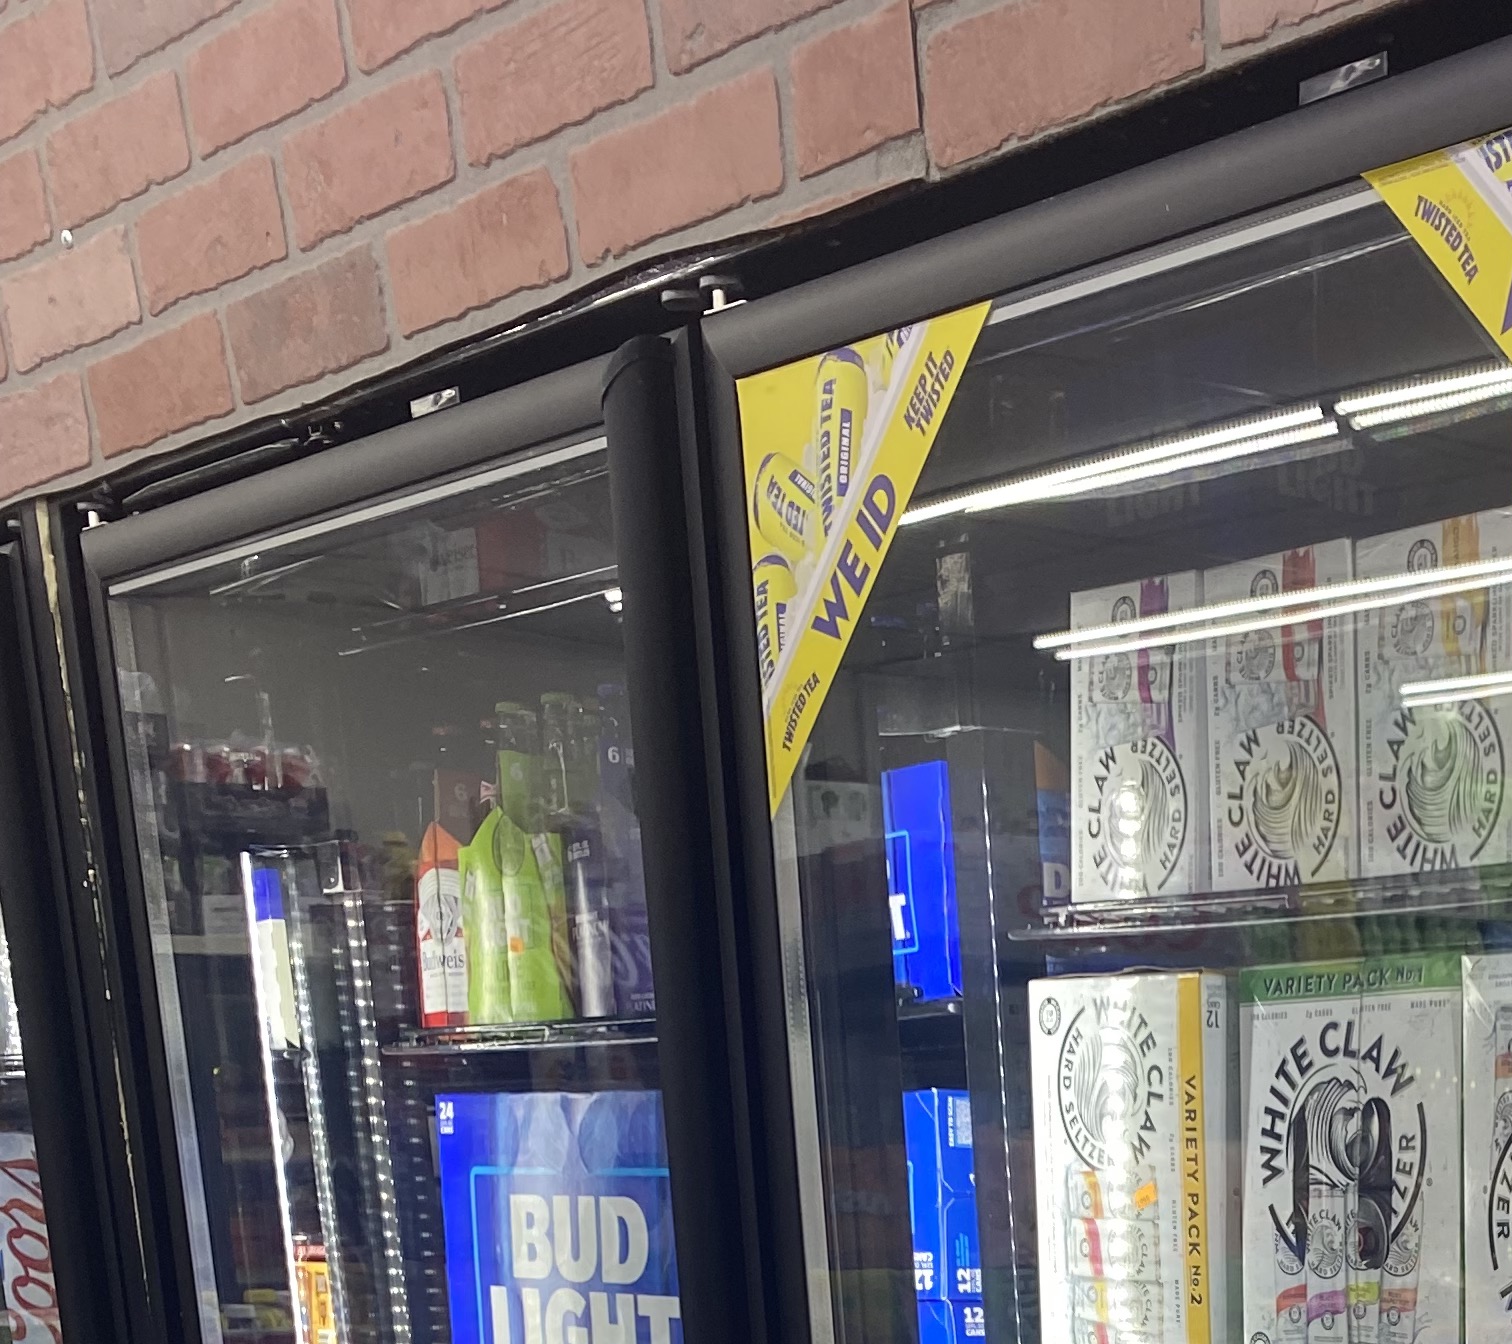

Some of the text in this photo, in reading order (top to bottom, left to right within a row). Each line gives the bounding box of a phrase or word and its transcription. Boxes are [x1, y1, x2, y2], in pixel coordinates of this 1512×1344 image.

[1415, 195, 1479, 285] TWISTED TEA
[904, 352, 936, 430] KEEP IT
[914, 350, 955, 437] TWISTED
[818, 378, 837, 537] TWISTED TEA
[839, 420, 851, 484] ORIGINAL
[811, 473, 896, 640] WE ID
[783, 672, 820, 752] TWISTED TEA
[1264, 965, 1424, 996] VARIETY PACK No.1
[438, 1101, 454, 1122] 24
[1260, 1020, 1415, 1187] WHITE CLAW
[1183, 1075, 1202, 1305] VARIETY PACK No.2
[509, 1192, 648, 1286] BUD
